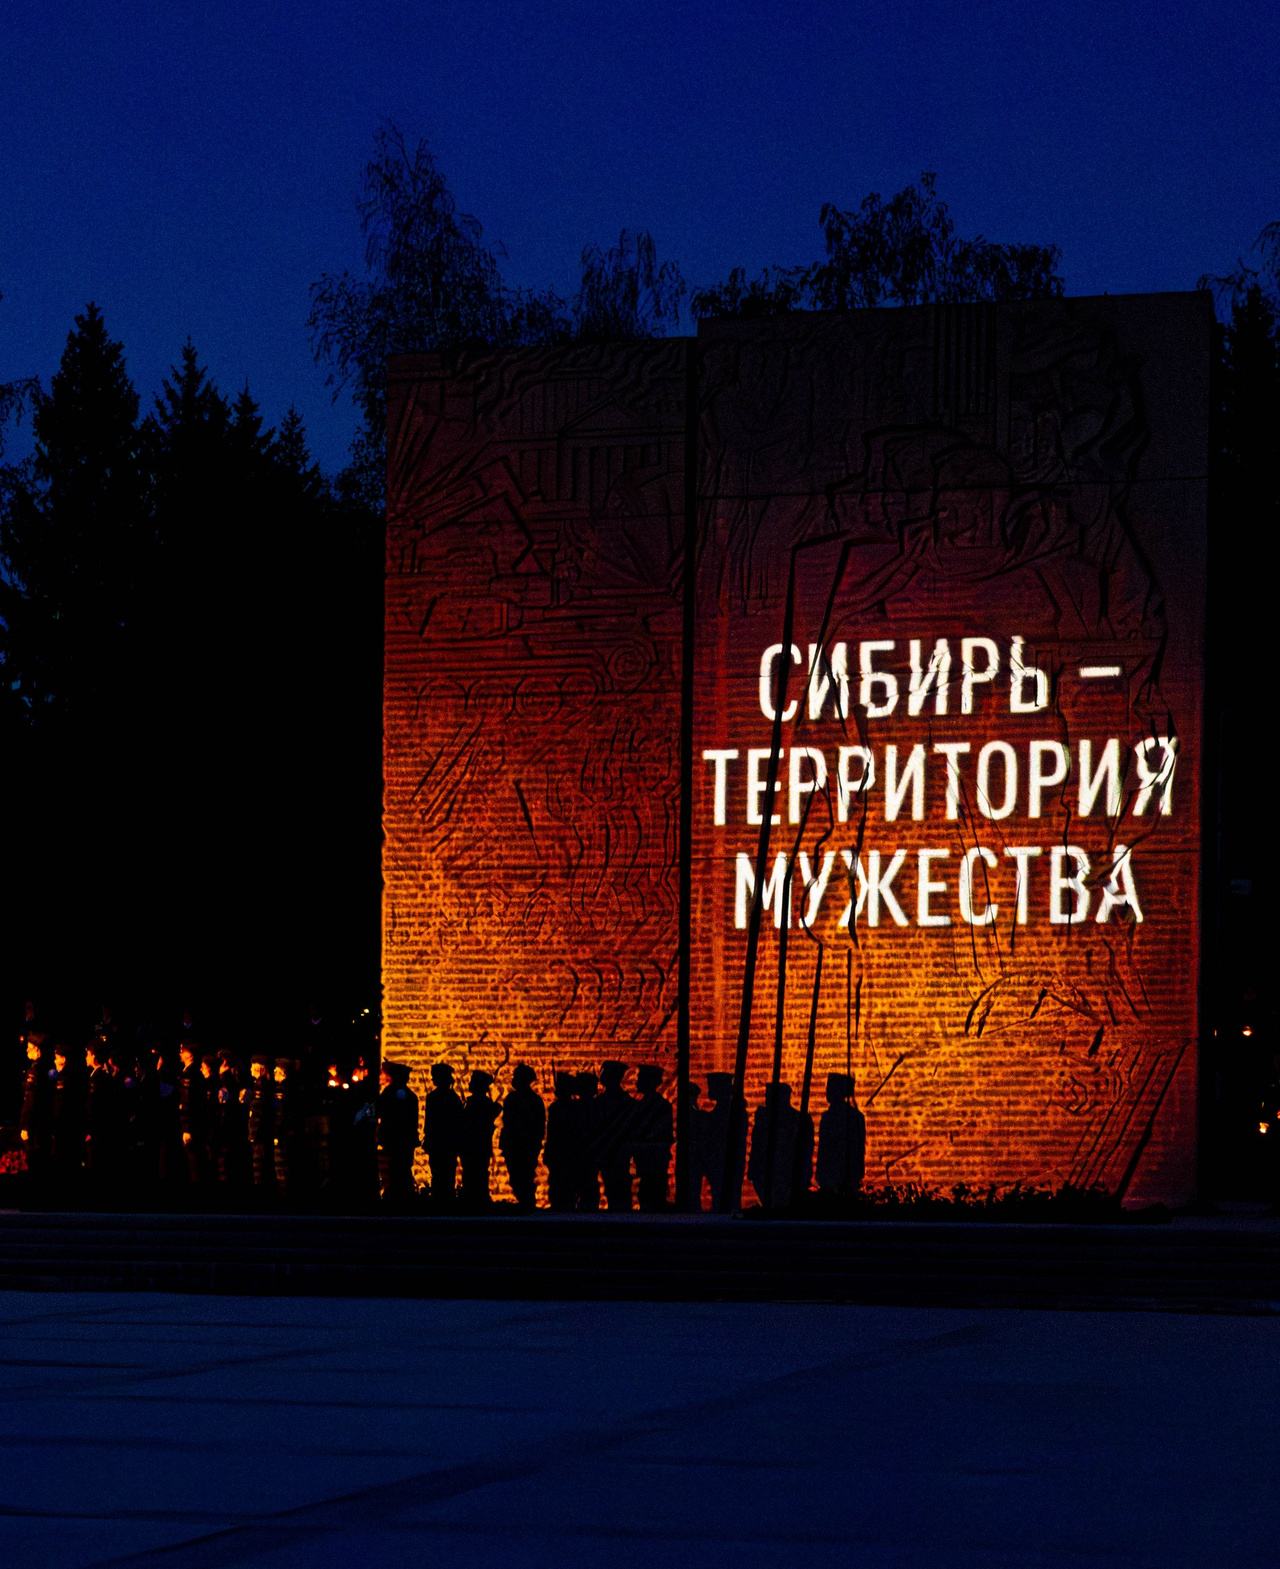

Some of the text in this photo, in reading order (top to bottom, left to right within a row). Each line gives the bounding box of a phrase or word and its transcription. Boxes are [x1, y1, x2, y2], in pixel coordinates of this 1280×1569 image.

[759, 636, 1047, 721] СИБИРЬ
[703, 737, 1176, 825] ТЕРРИТОРИЯ
[735, 845, 1143, 928] МУЖЕСТВА
